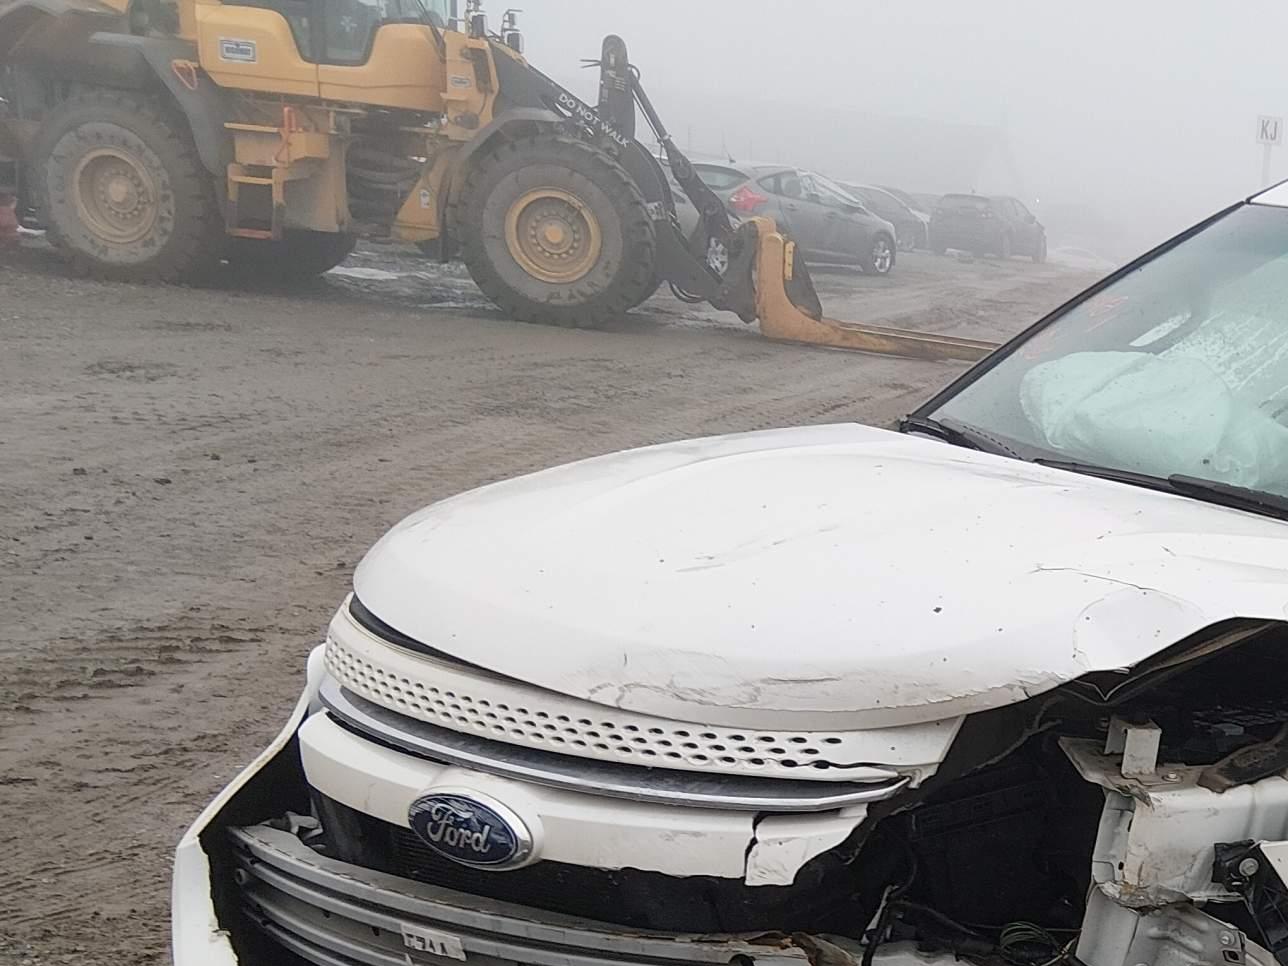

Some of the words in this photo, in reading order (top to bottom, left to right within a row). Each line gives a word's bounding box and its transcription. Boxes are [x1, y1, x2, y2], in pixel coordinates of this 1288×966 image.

[560, 93, 576, 109] DO
[576, 106, 600, 125] NOT
[601, 122, 629, 148] WALK
[1261, 119, 1278, 140] KJ
[426, 803, 491, 853] Ford
